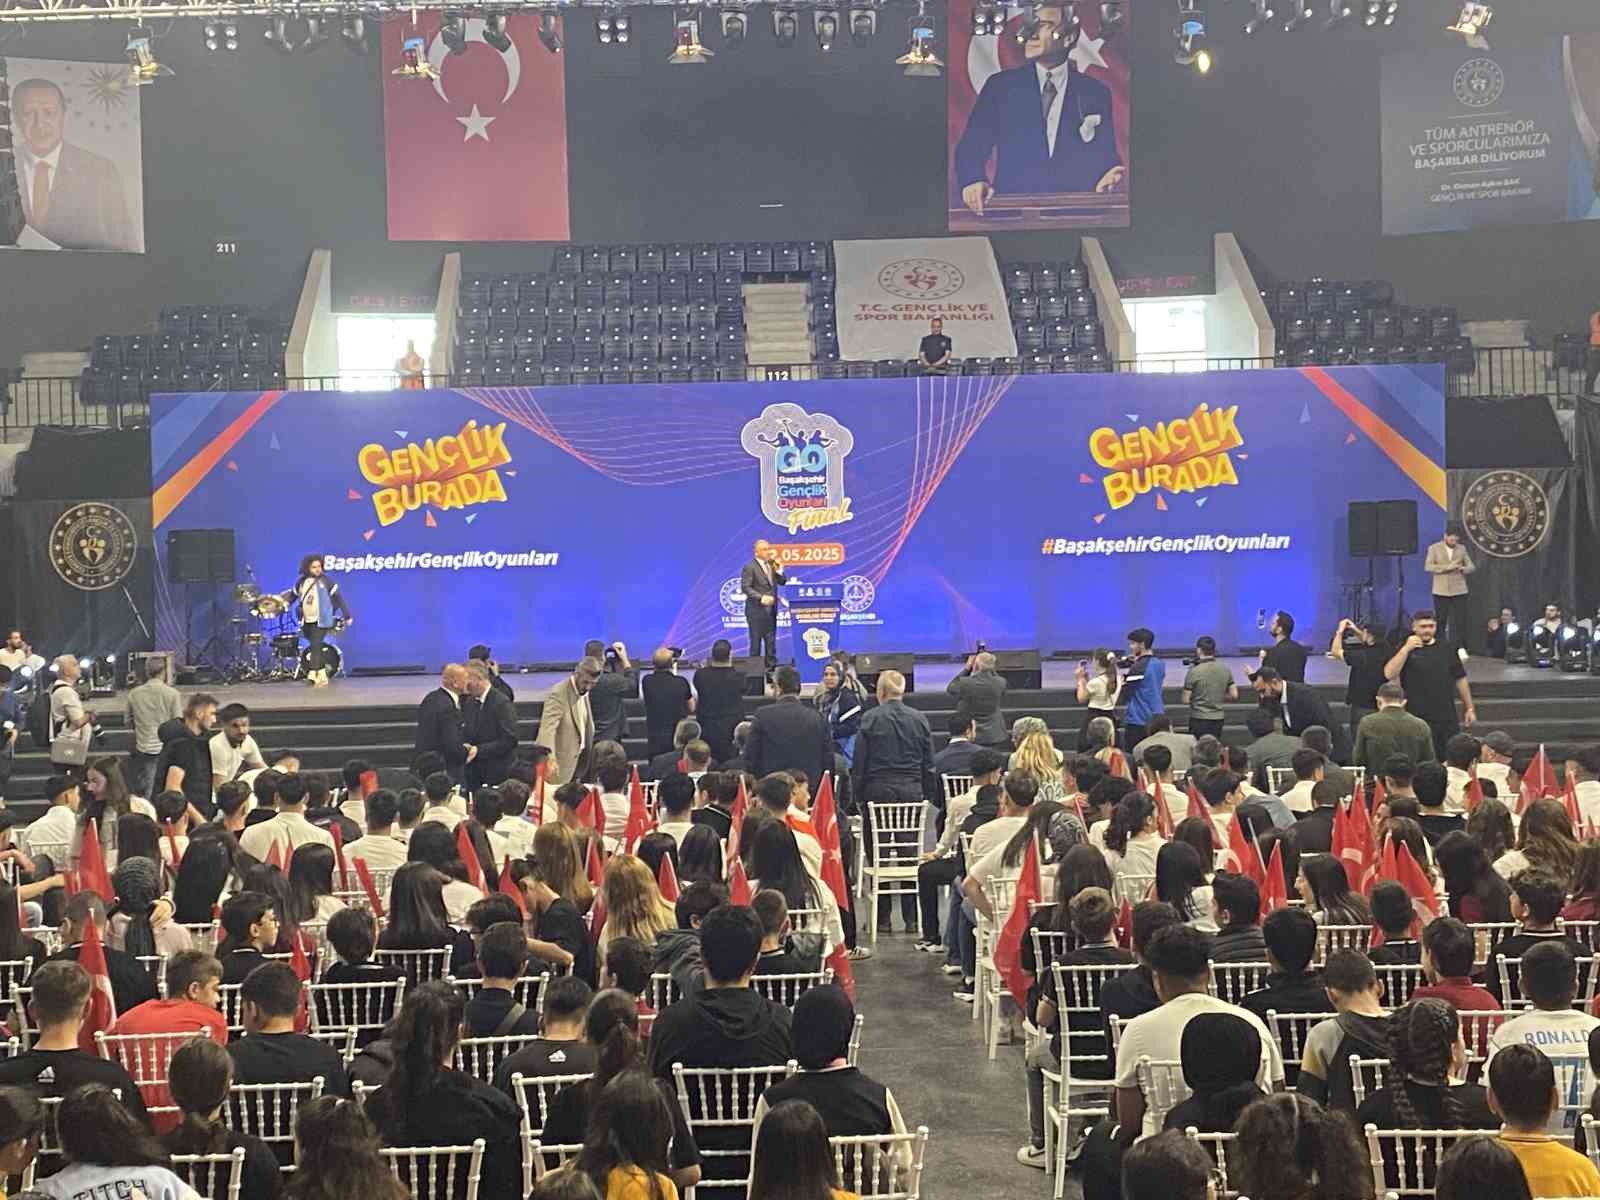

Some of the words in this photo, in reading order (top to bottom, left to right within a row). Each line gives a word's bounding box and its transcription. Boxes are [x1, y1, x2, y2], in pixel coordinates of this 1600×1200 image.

[1409, 143, 1427, 157] VE
[216, 243, 236, 253] 211
[854, 313, 899, 321] SPOR
[965, 303, 989, 312] VE
[767, 370, 789, 381] 112
[1089, 402, 1244, 469] GENÇLİK
[357, 419, 512, 486] GENÇLİK
[775, 443, 827, 473] GO
[1103, 452, 1239, 510] BURADA
[371, 469, 508, 527] BURADA
[779, 484, 826, 499] Gençlik
[768, 547, 840, 562] 2.05.2025
[1041, 533, 1291, 556] #BaşakşehirGençlikOyunları
[324, 550, 559, 572] BaşakşehirGençlikOyunları
[1524, 1029, 1590, 1049] RONALD
